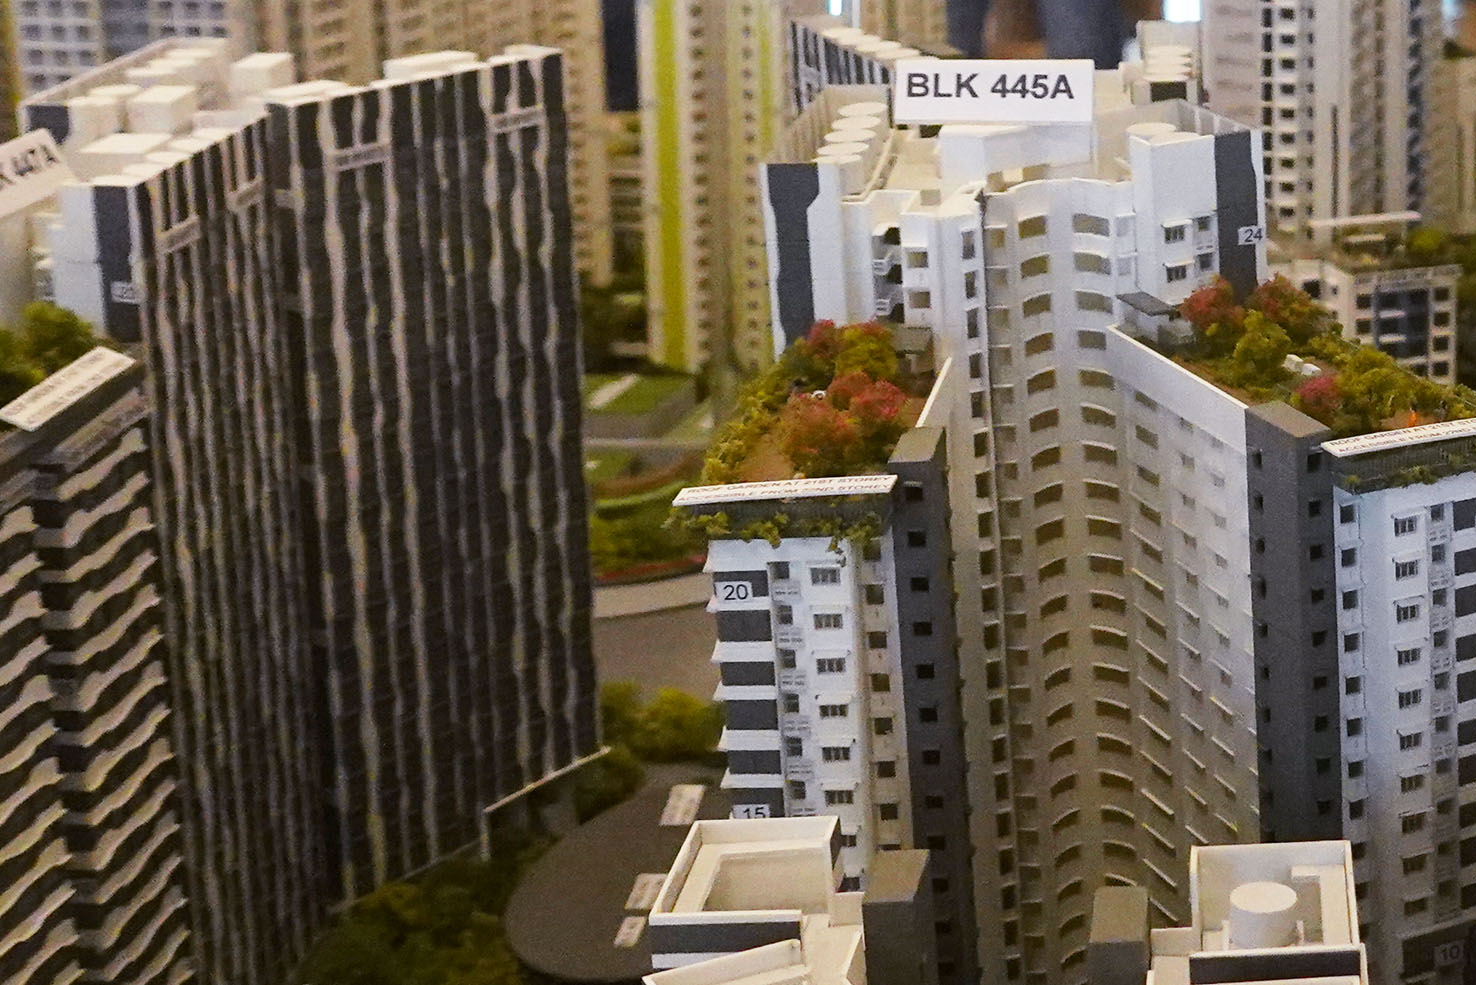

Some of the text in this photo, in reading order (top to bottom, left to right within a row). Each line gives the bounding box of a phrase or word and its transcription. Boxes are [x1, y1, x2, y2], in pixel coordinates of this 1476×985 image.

[907, 73, 1074, 99] BLK 445A
[1244, 228, 1263, 243] 24
[723, 584, 748, 600] 20
